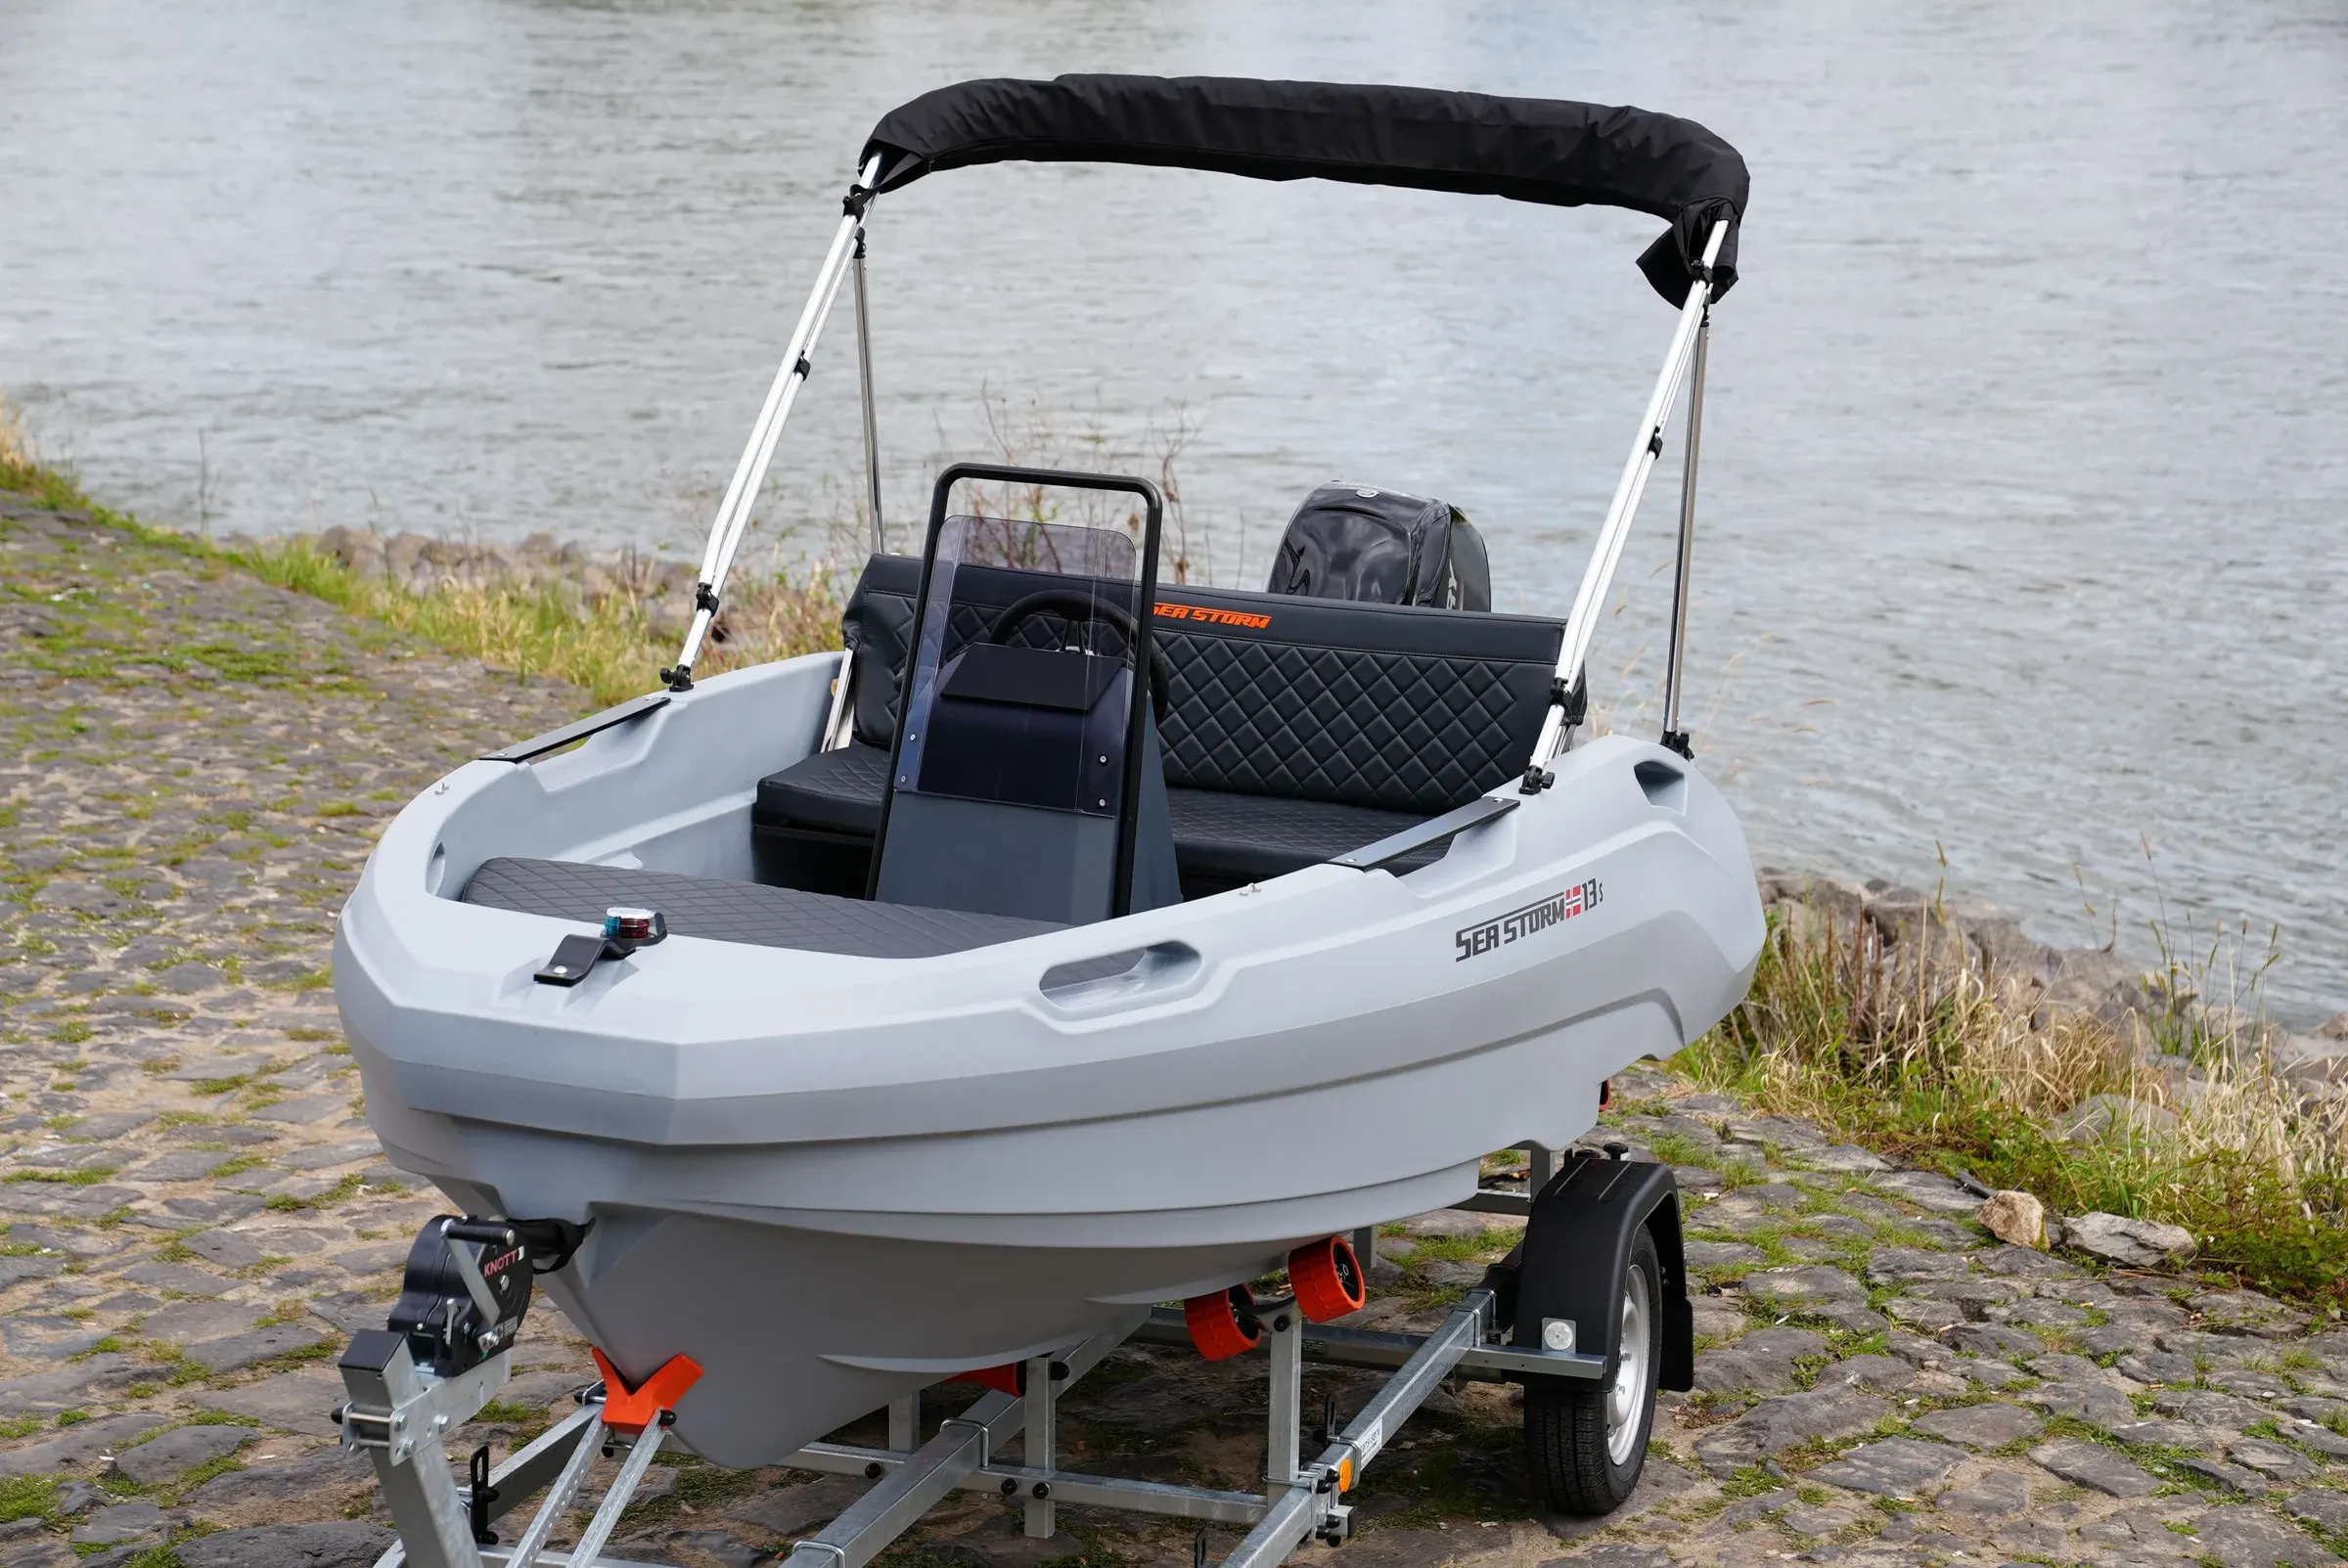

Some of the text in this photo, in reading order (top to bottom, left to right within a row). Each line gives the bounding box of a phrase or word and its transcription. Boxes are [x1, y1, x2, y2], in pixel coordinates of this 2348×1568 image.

[1190, 608, 1272, 629] STORM
[1456, 924, 1499, 963] SEA
[1504, 897, 1565, 945] STORM
[483, 1248, 518, 1277] KNOTT
